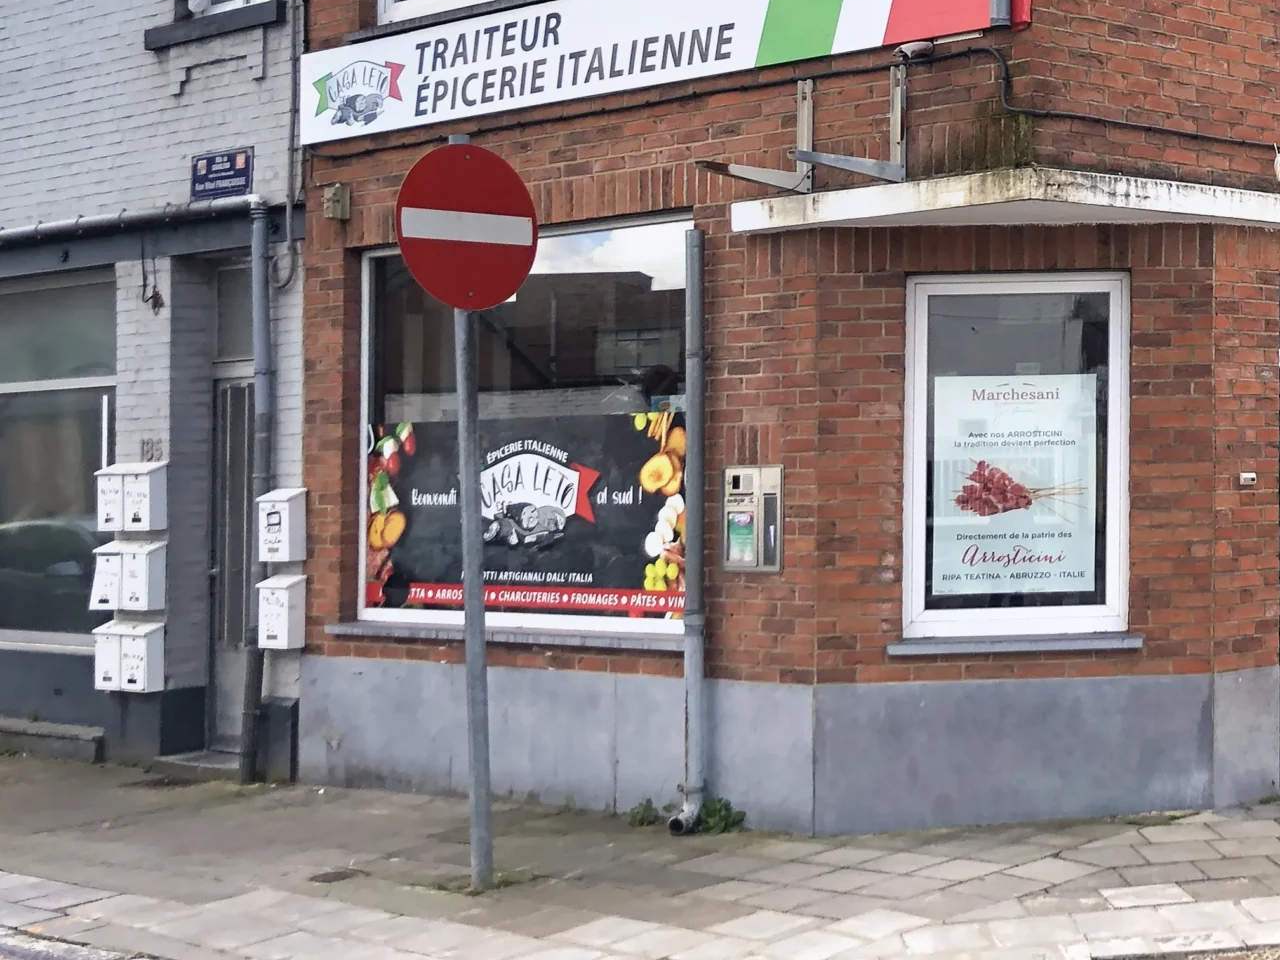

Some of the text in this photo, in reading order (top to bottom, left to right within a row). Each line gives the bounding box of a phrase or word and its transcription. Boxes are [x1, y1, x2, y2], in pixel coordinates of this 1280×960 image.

[414, 12, 562, 75] TRAITEUR
[414, 23, 736, 117] ÉPICERIE ITALIENNE
[328, 66, 388, 102] CASA LETO
[972, 387, 1060, 401] Marchesani
[1007, 430, 1063, 438] ARROSTICINI
[486, 439, 568, 464] ÉPICERIE ITALIENNE
[954, 439, 1076, 448] la tradition devient perfection
[480, 461, 575, 509] CASA LETO
[411, 487, 458, 506] Benvenuti
[596, 486, 608, 505] al
[612, 488, 633, 505] sud
[956, 532, 1008, 541] Directement
[1021, 531, 1029, 539] la
[1031, 531, 1056, 540] patrie
[1058, 531, 1072, 539] des
[497, 571, 546, 582] ARTIGIANALI
[568, 572, 593, 583] ITALIA
[942, 573, 962, 581] RIPA
[964, 572, 1001, 581] TEATINA
[1009, 571, 1051, 580] ABRUZZO
[1059, 570, 1086, 578] ITALIE
[498, 590, 560, 604] CHARCUTERIES
[570, 592, 618, 606] FROMAGES
[630, 593, 657, 607] PÂTES
